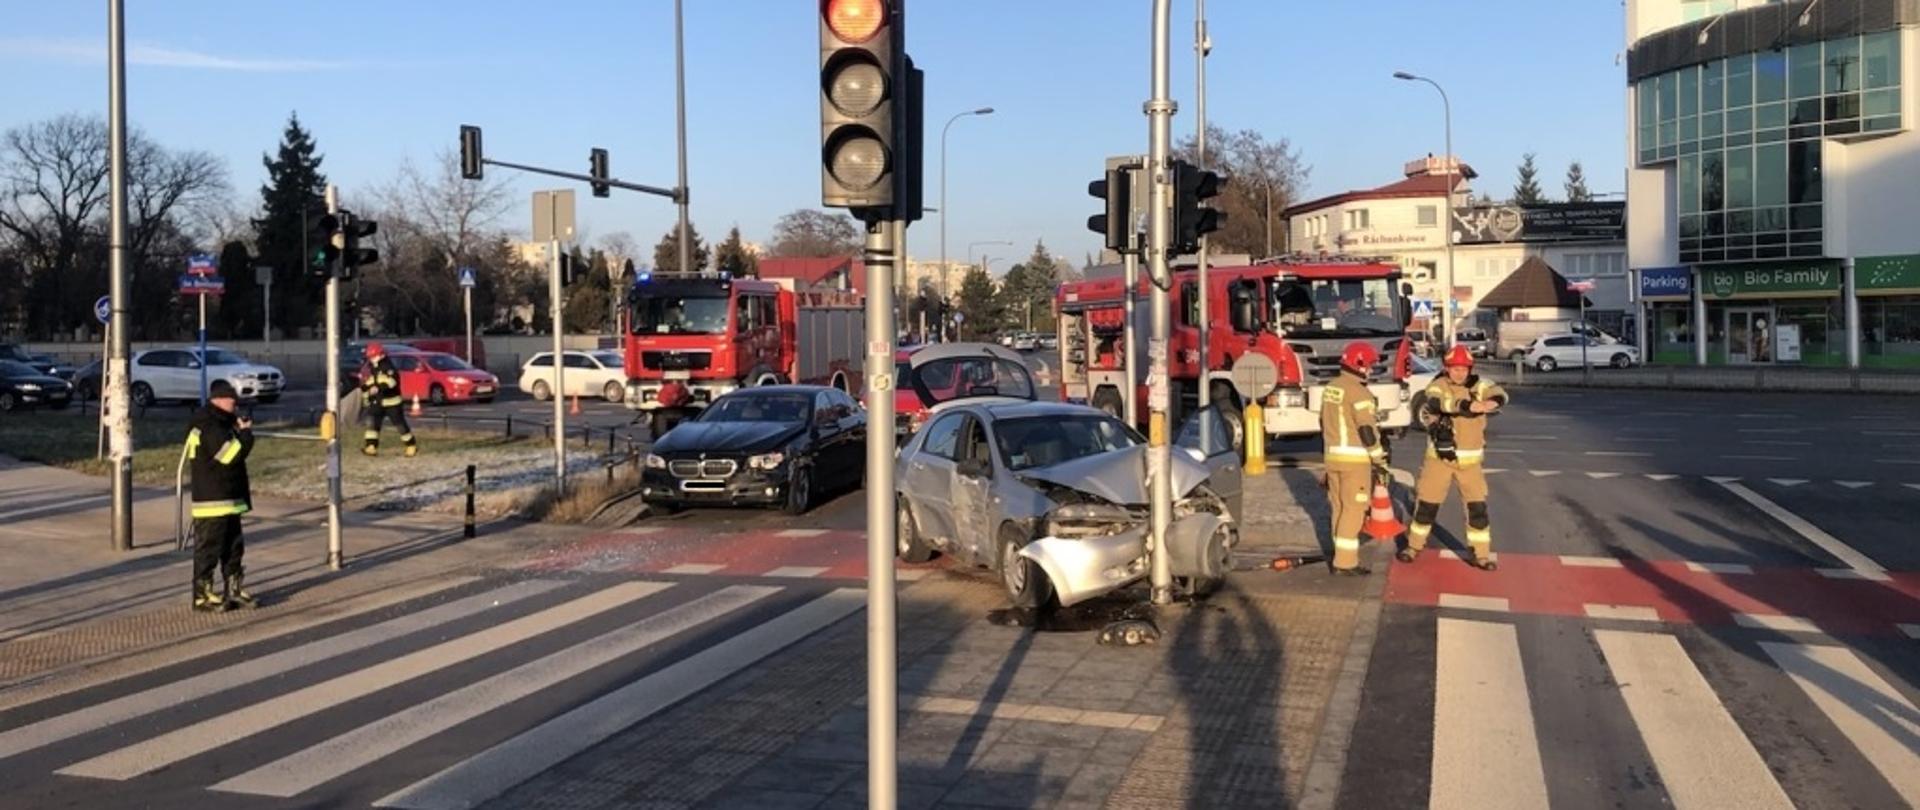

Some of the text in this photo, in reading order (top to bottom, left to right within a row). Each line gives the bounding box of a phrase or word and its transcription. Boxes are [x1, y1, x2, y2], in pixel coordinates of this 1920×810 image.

[1643, 275, 1688, 289] Parking
[1713, 271, 1734, 286] bio
[1744, 269, 1829, 285] Bio Family
